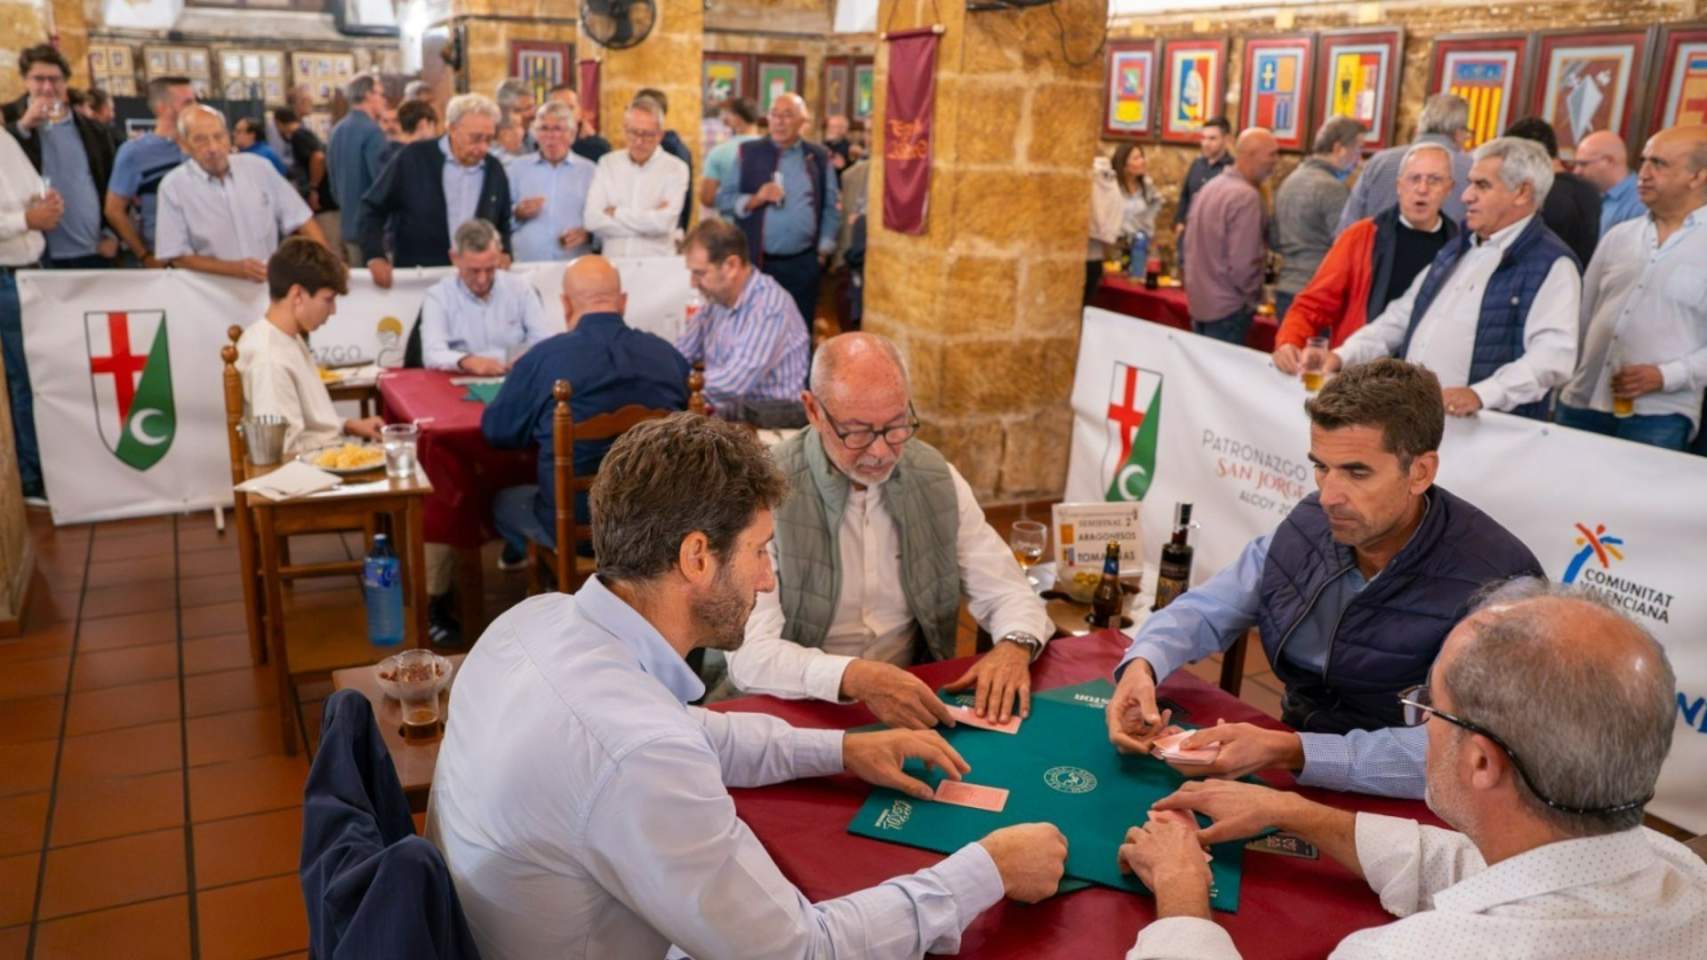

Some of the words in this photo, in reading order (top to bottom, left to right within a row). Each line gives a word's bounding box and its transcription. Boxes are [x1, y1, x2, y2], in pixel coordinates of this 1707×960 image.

[1202, 429, 1307, 482] PATRONAZGO
[1215, 457, 1253, 480] SAN
[1255, 470, 1305, 499] JORGE
[1585, 568, 1674, 608] COMUNITAT
